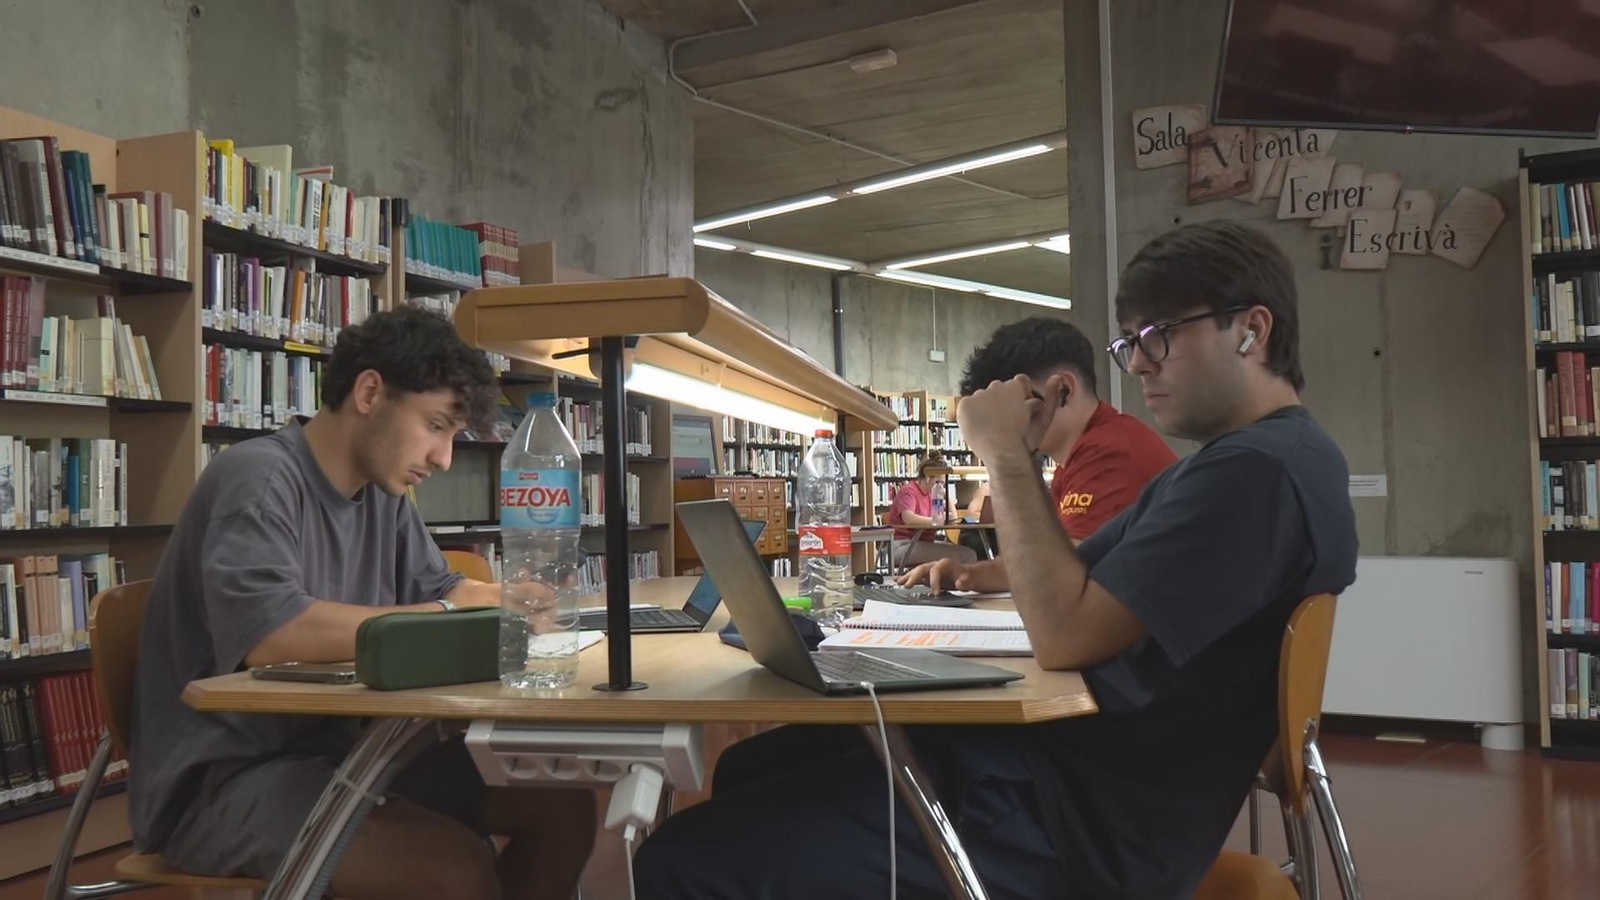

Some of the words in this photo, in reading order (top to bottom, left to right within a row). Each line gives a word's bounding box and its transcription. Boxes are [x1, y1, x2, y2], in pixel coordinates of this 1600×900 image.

[1136, 112, 1187, 156] Sala
[1208, 127, 1321, 168] Vicenta
[1290, 175, 1373, 214] Ferrer
[1349, 218, 1459, 254] Escrivà
[501, 486, 571, 508] BEZOYA
